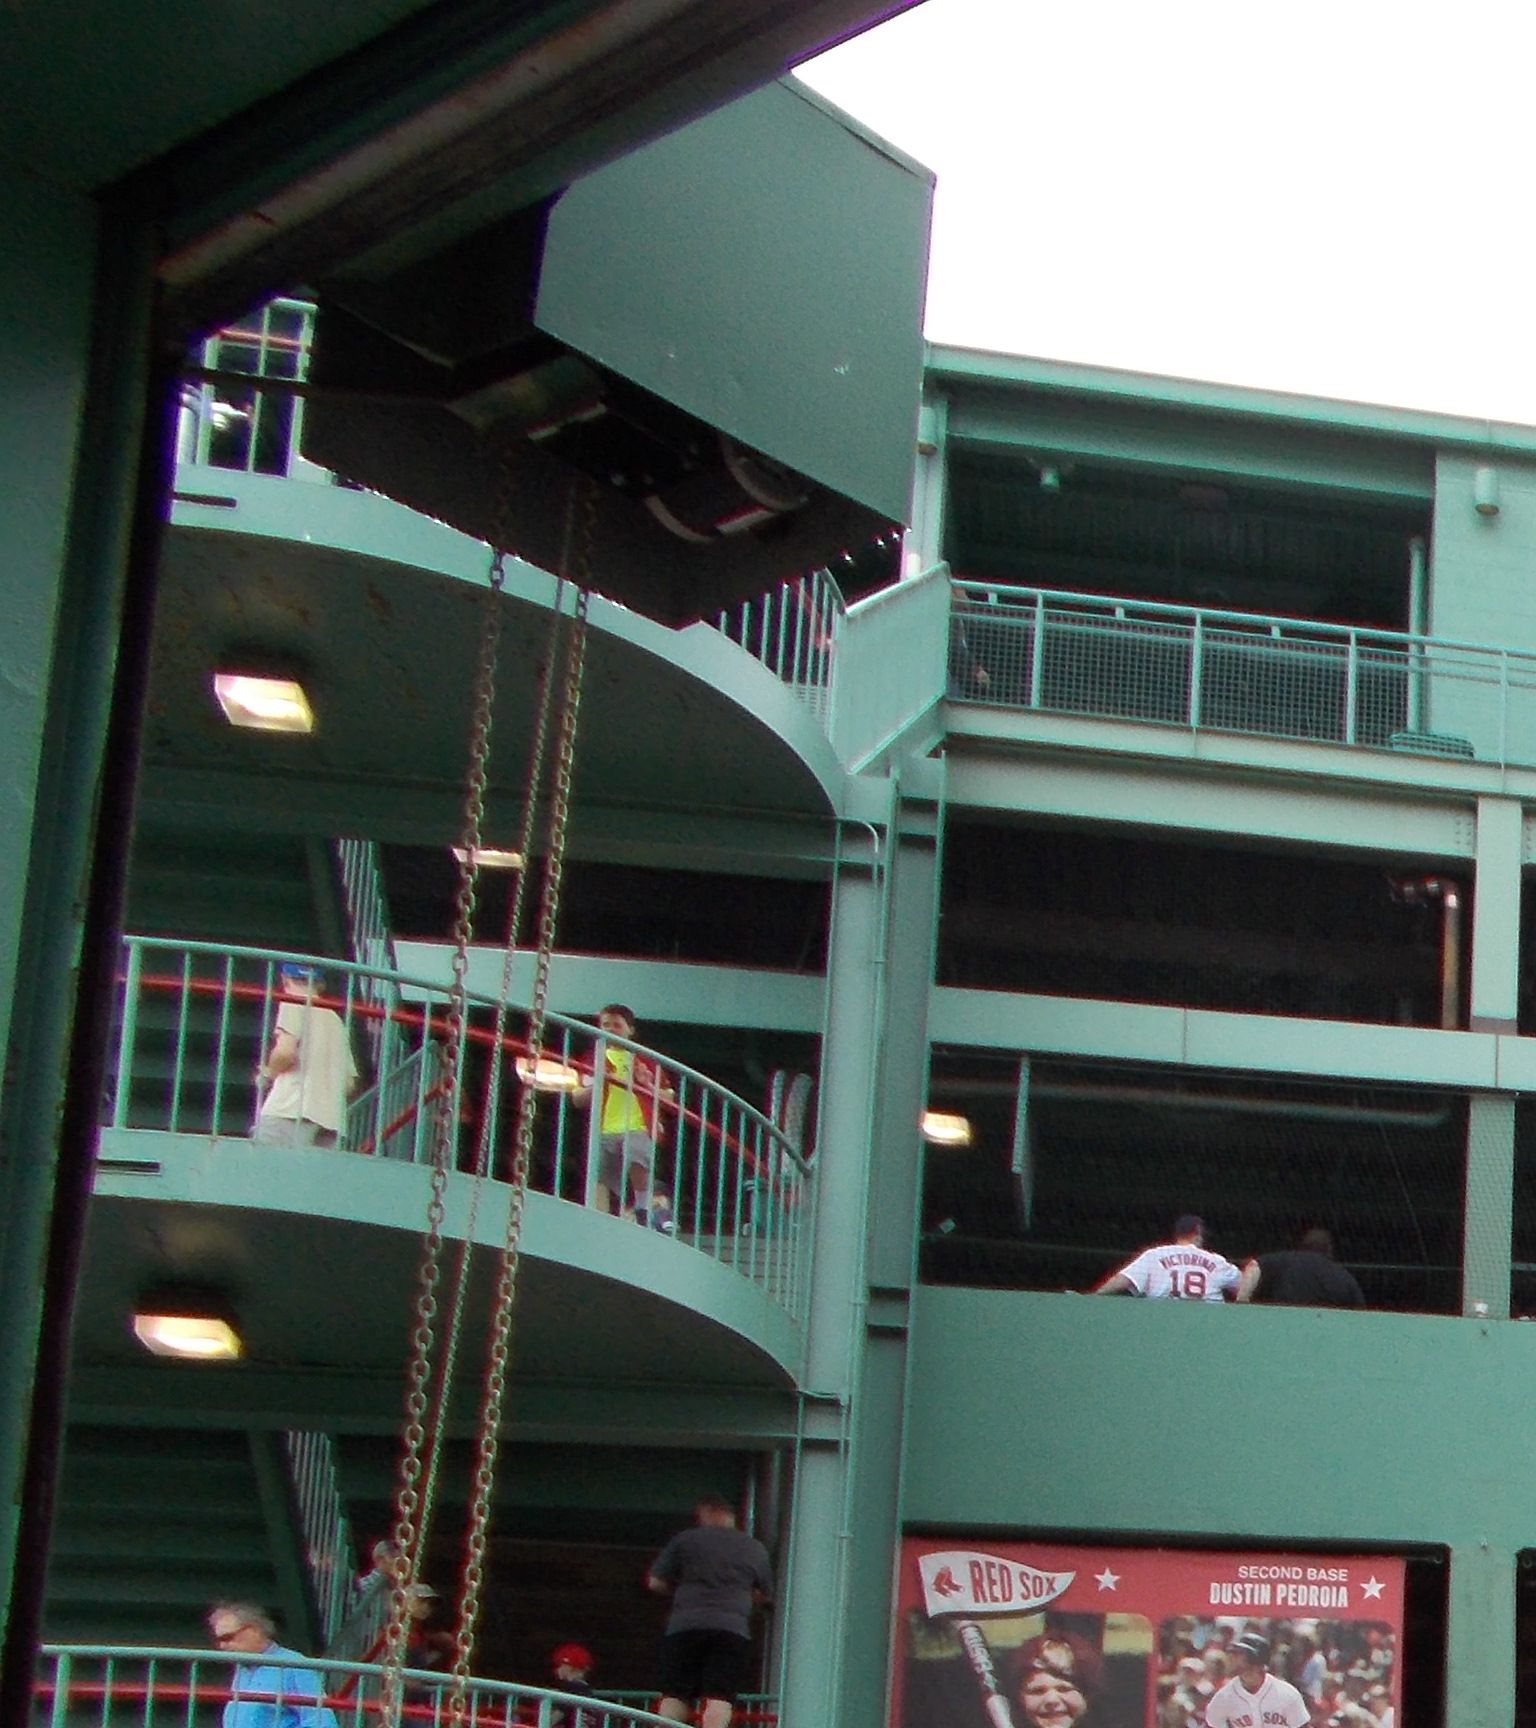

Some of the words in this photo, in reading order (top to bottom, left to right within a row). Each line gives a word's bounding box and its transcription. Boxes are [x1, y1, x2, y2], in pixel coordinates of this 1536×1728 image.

[1169, 1270, 1208, 1298] 18
[968, 1560, 1014, 1605] RED
[1019, 1571, 1058, 1599] SOX
[1238, 1564, 1300, 1582] SECOND
[1306, 1566, 1349, 1583] BASE
[1209, 1582, 1271, 1607] DUSTIN
[1276, 1582, 1349, 1609] PEDROIA
